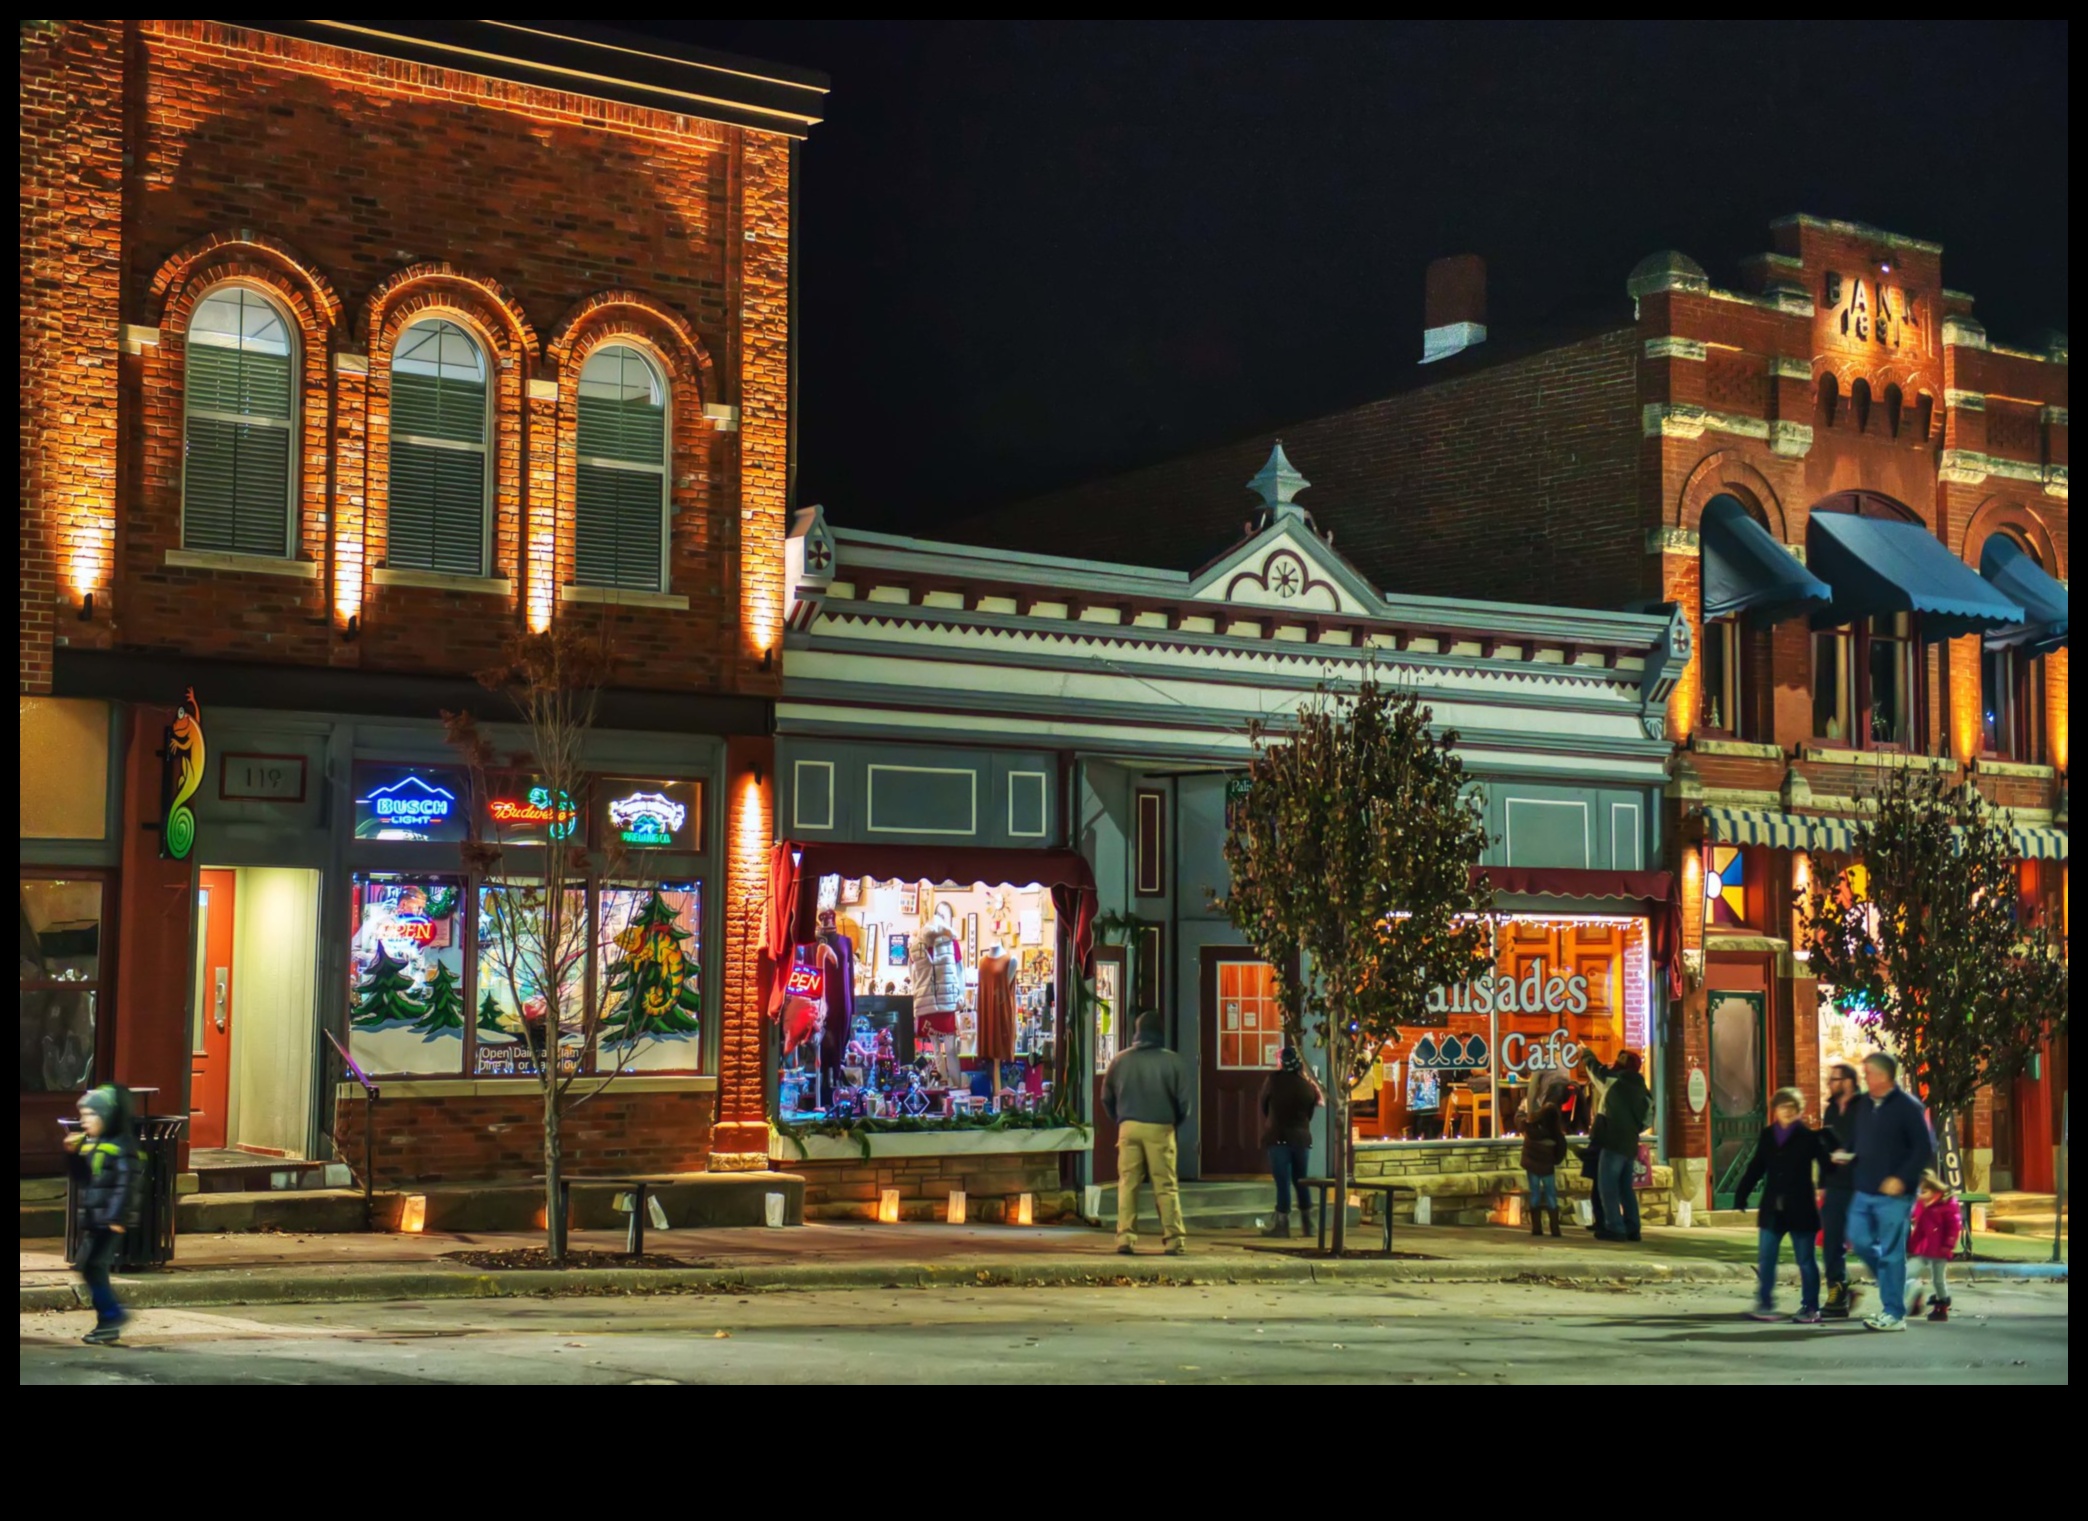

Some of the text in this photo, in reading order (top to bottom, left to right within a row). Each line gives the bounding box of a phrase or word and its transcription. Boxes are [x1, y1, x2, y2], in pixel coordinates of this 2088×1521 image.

[1825, 271, 1919, 326] BANK
[377, 798, 448, 815] BUSCH
[391, 815, 431, 824] LIGHT
[788, 971, 821, 991] PEN
[1419, 957, 1588, 1014] alisades
[482, 1047, 509, 1060] Open
[1502, 1028, 1580, 1071] Cafe
[518, 1061, 530, 1070] or
